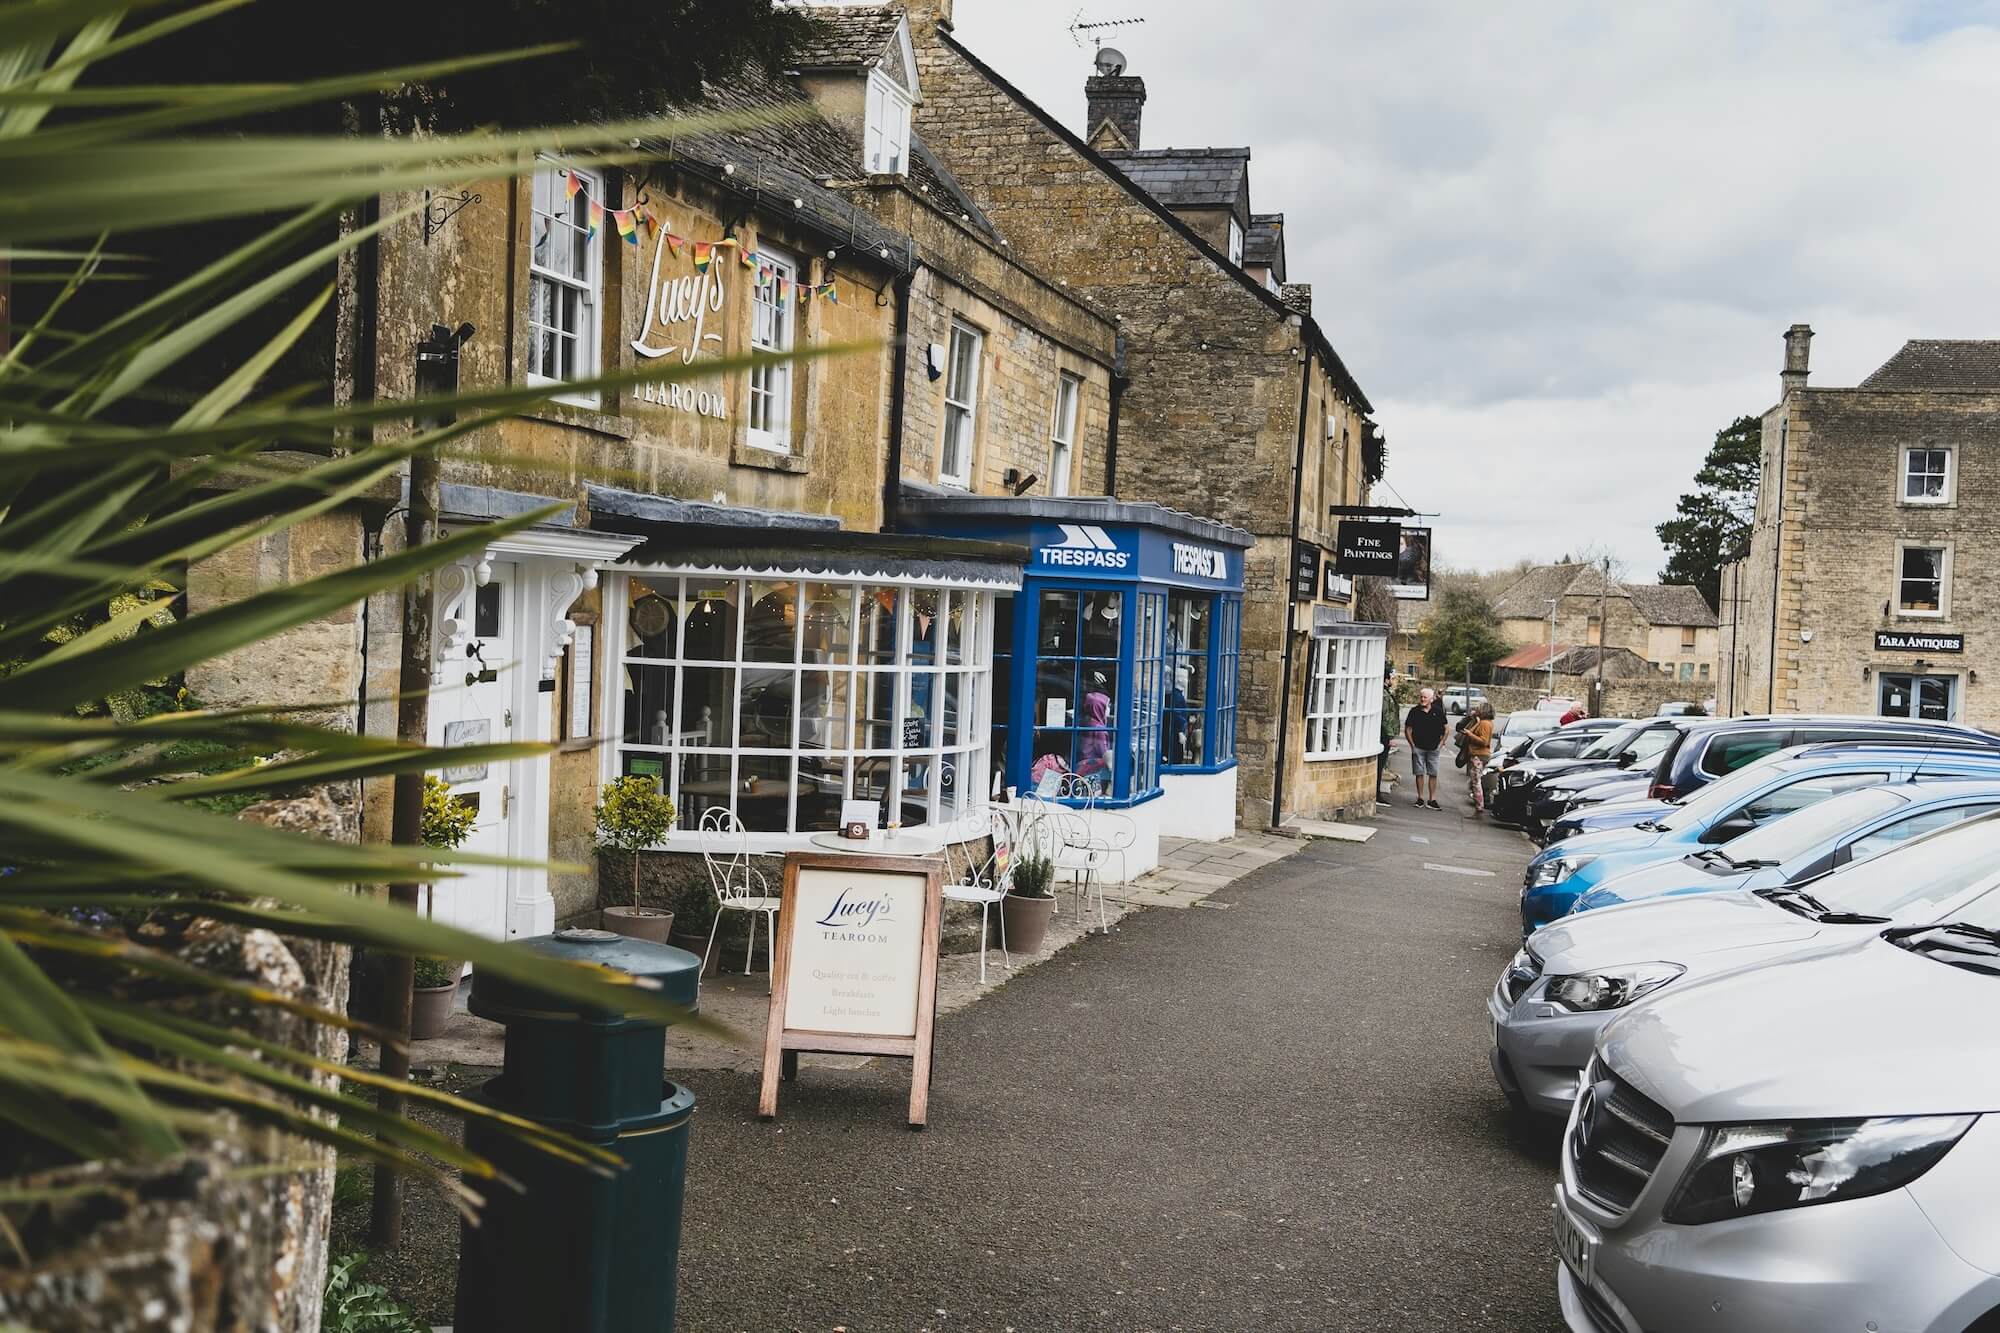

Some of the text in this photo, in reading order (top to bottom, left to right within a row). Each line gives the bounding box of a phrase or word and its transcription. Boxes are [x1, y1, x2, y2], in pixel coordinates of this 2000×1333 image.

[631, 221, 724, 366] Lucy's
[632, 379, 726, 420] TEAROOM
[1039, 548, 1128, 568] TRESPASS
[1173, 542, 1213, 577] TRESPASS
[816, 887, 894, 928] Lucy's
[822, 931, 888, 944] TEAROOM
[812, 968, 844, 982] Quality
